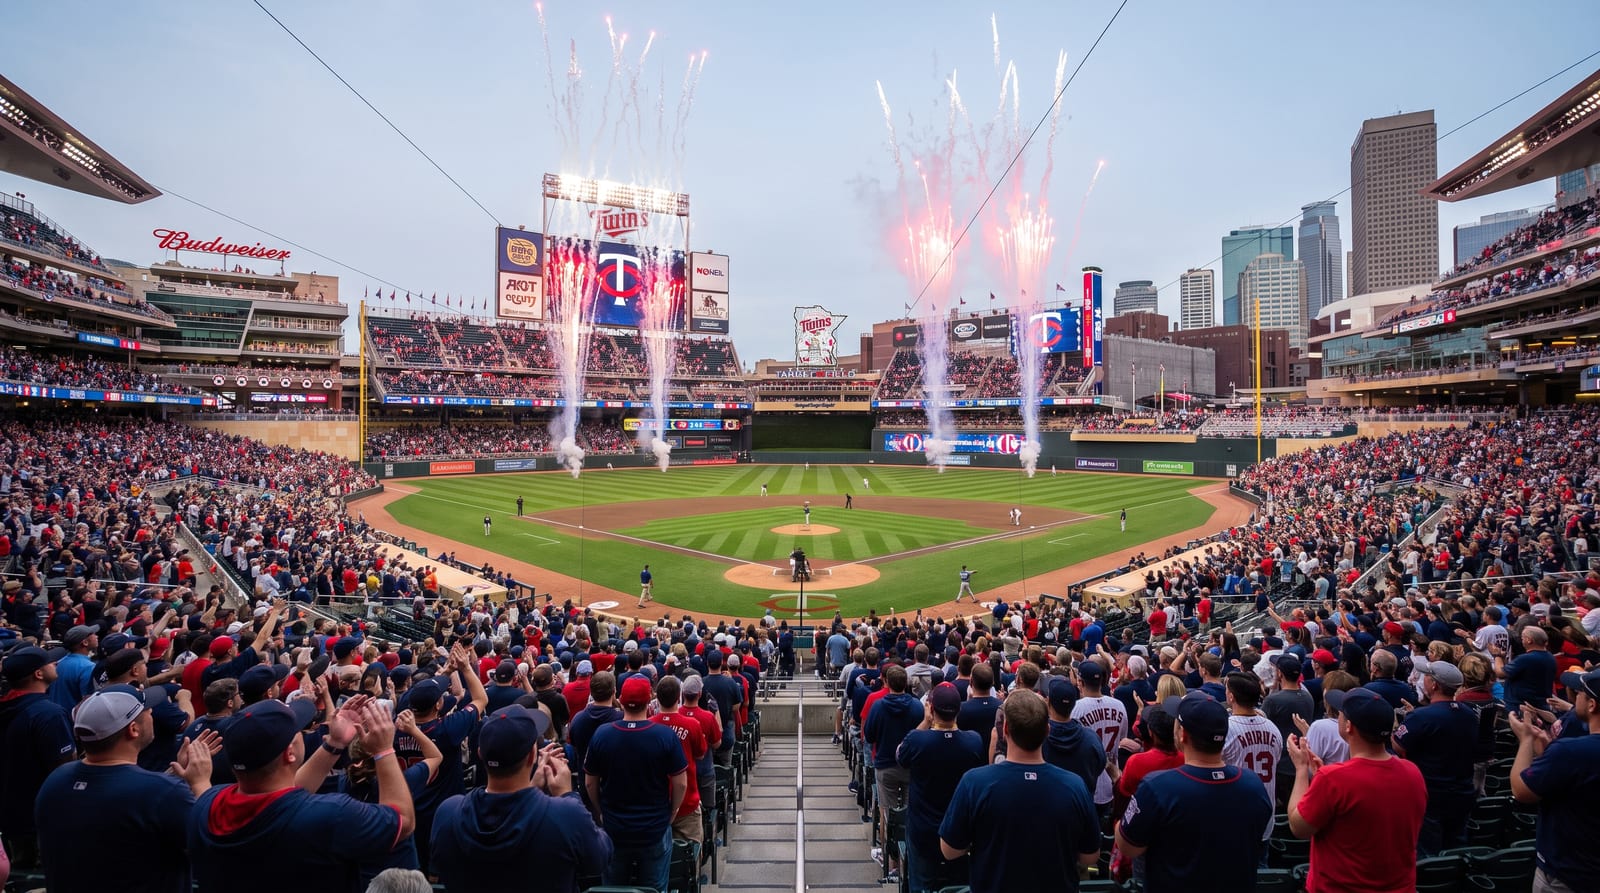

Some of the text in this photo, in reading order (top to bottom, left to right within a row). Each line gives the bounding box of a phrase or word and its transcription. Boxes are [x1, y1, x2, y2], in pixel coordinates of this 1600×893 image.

[590, 208, 648, 237] Twins
[153, 229, 291, 259] Budweiser
[800, 317, 832, 334] Twins
[1096, 726, 1120, 752] 17
[1244, 751, 1274, 783] 13
